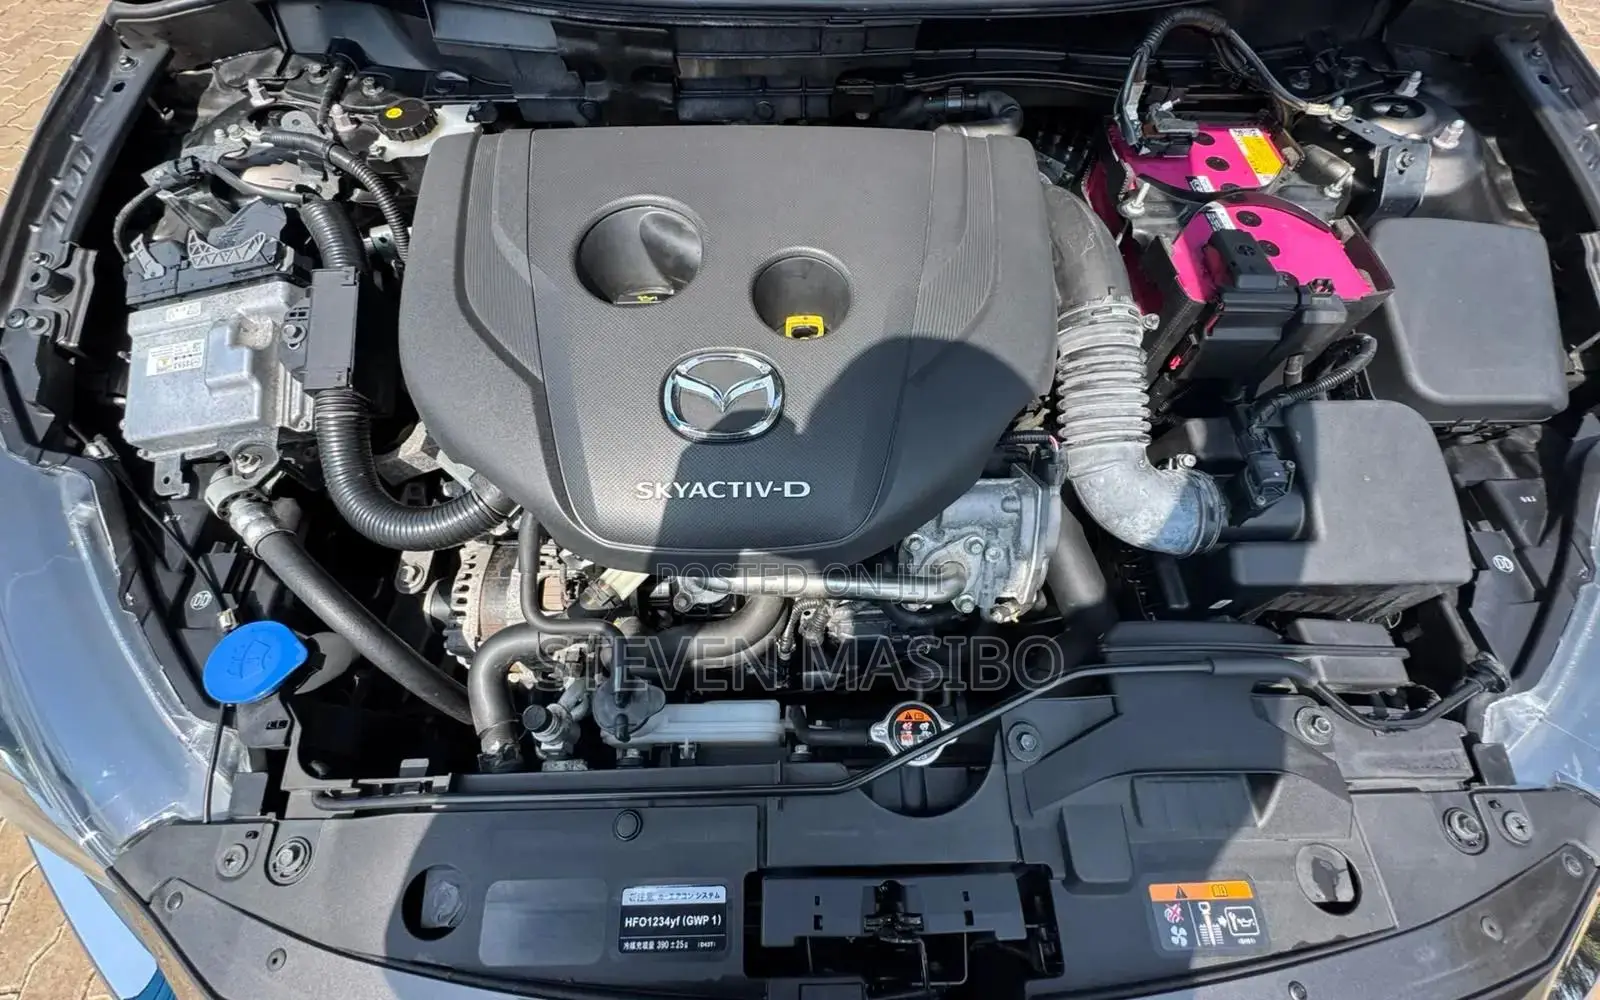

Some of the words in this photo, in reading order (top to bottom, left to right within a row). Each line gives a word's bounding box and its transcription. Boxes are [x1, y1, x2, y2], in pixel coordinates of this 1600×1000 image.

[635, 480, 811, 499] SKYACTIV-D
[624, 916, 681, 929] HFO1234yf
[682, 914, 709, 926] (GWP
[711, 914, 722, 926] 1)
